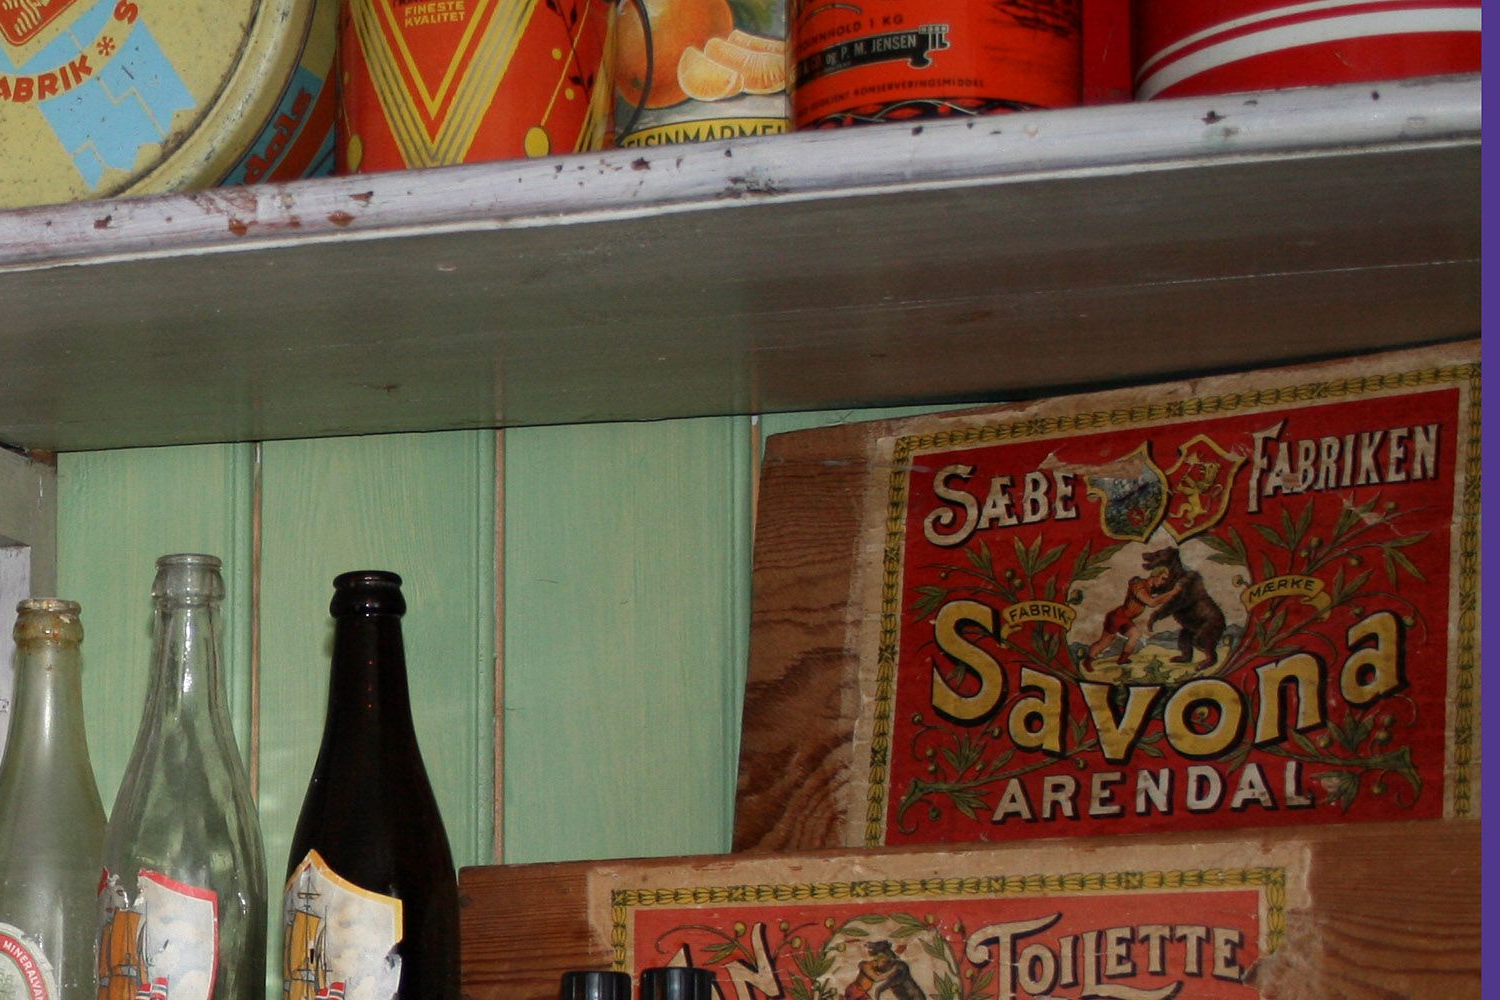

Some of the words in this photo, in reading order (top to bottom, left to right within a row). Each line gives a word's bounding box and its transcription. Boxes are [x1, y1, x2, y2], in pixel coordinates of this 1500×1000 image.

[404, 0, 464, 17] FINESTE
[404, 11, 465, 28] KVALITET
[870, 34, 917, 53] JENSEN
[923, 464, 1081, 546] SÆBE
[1247, 420, 1441, 514] FABRIKEN
[1248, 576, 1316, 601] MÆRKE
[931, 600, 1408, 763] Savona
[991, 762, 1313, 823] ARENDAL
